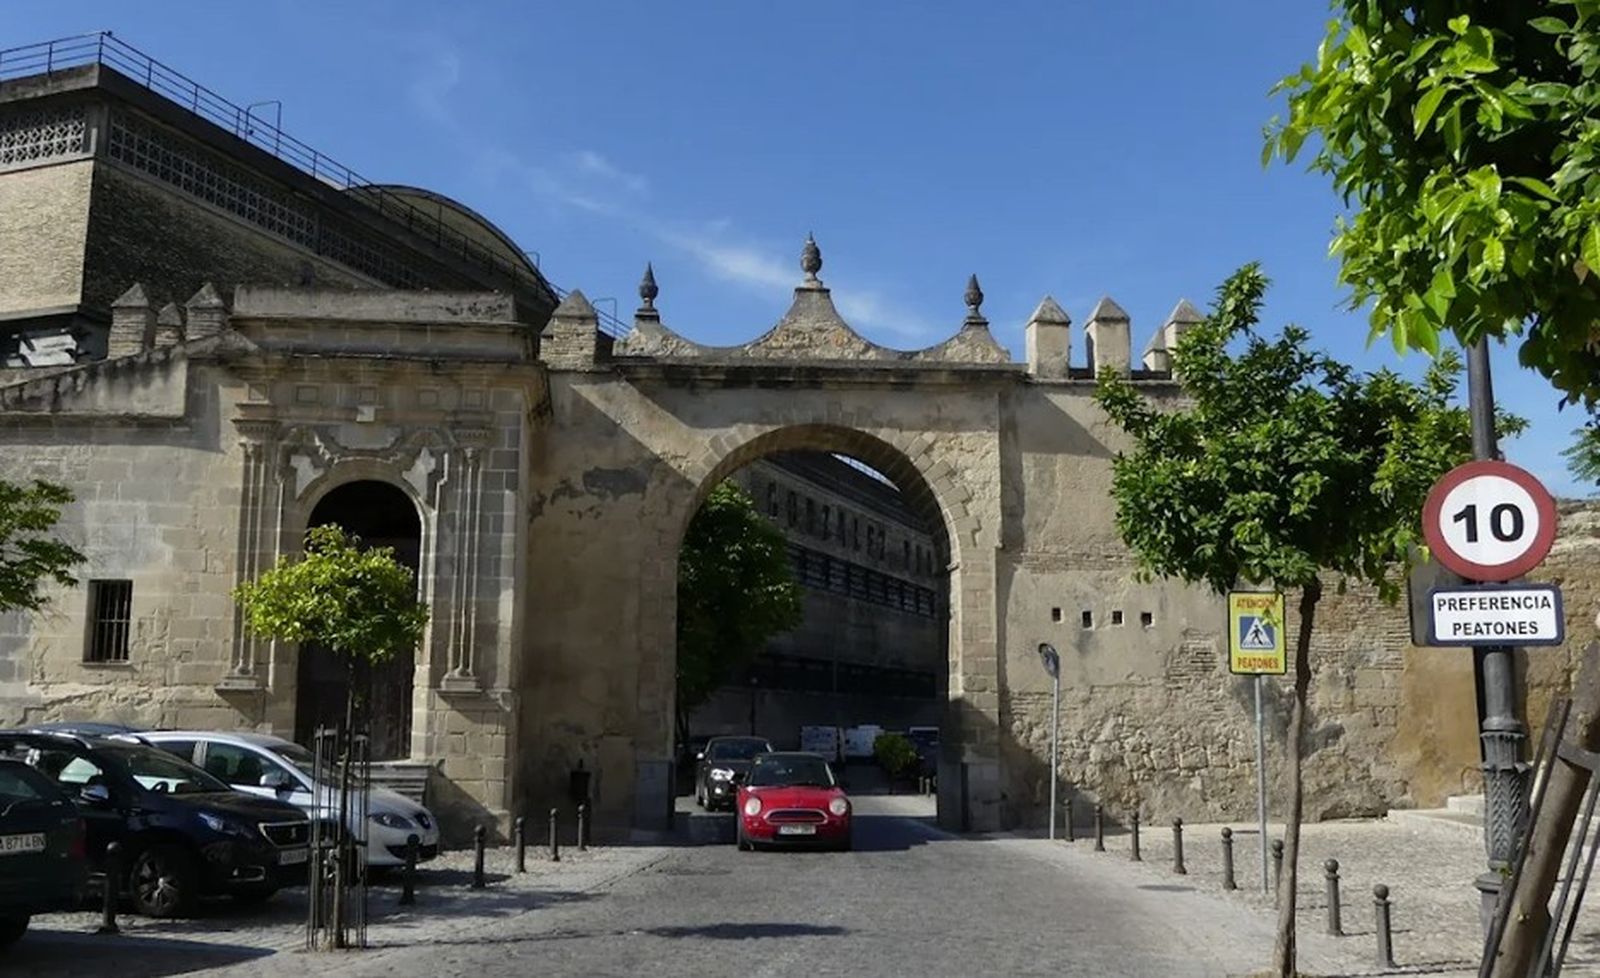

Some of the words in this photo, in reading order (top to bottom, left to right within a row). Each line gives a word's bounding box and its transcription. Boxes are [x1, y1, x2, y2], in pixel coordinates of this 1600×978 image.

[1453, 503, 1524, 543] 10
[1438, 596, 1551, 611] PREFERENCIA
[1453, 621, 1538, 636] PEATONES
[1238, 657, 1279, 669] PEATONES
